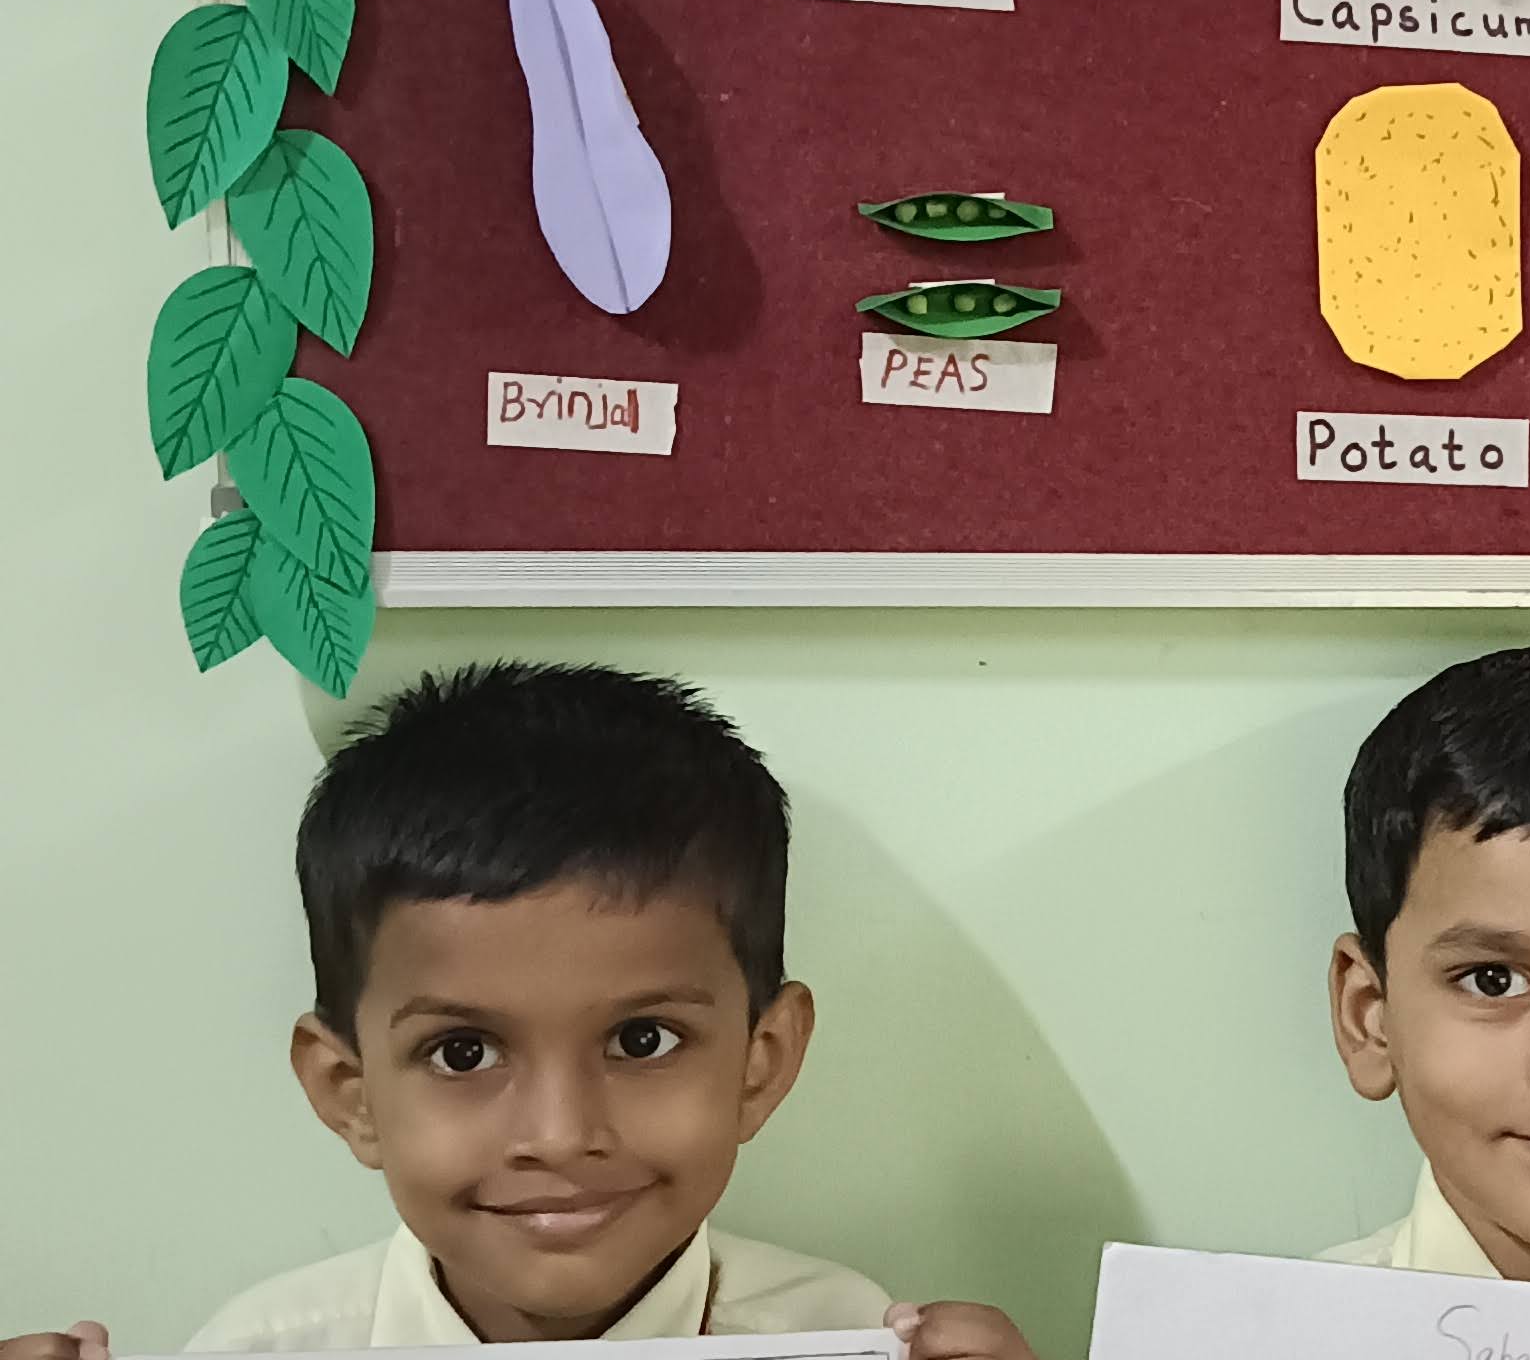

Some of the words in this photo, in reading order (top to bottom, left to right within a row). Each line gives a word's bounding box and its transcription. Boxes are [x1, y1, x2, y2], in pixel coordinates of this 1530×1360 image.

[880, 347, 990, 396] PEAS
[500, 375, 640, 435] Brinjal
[1307, 419, 1506, 473] Potato
